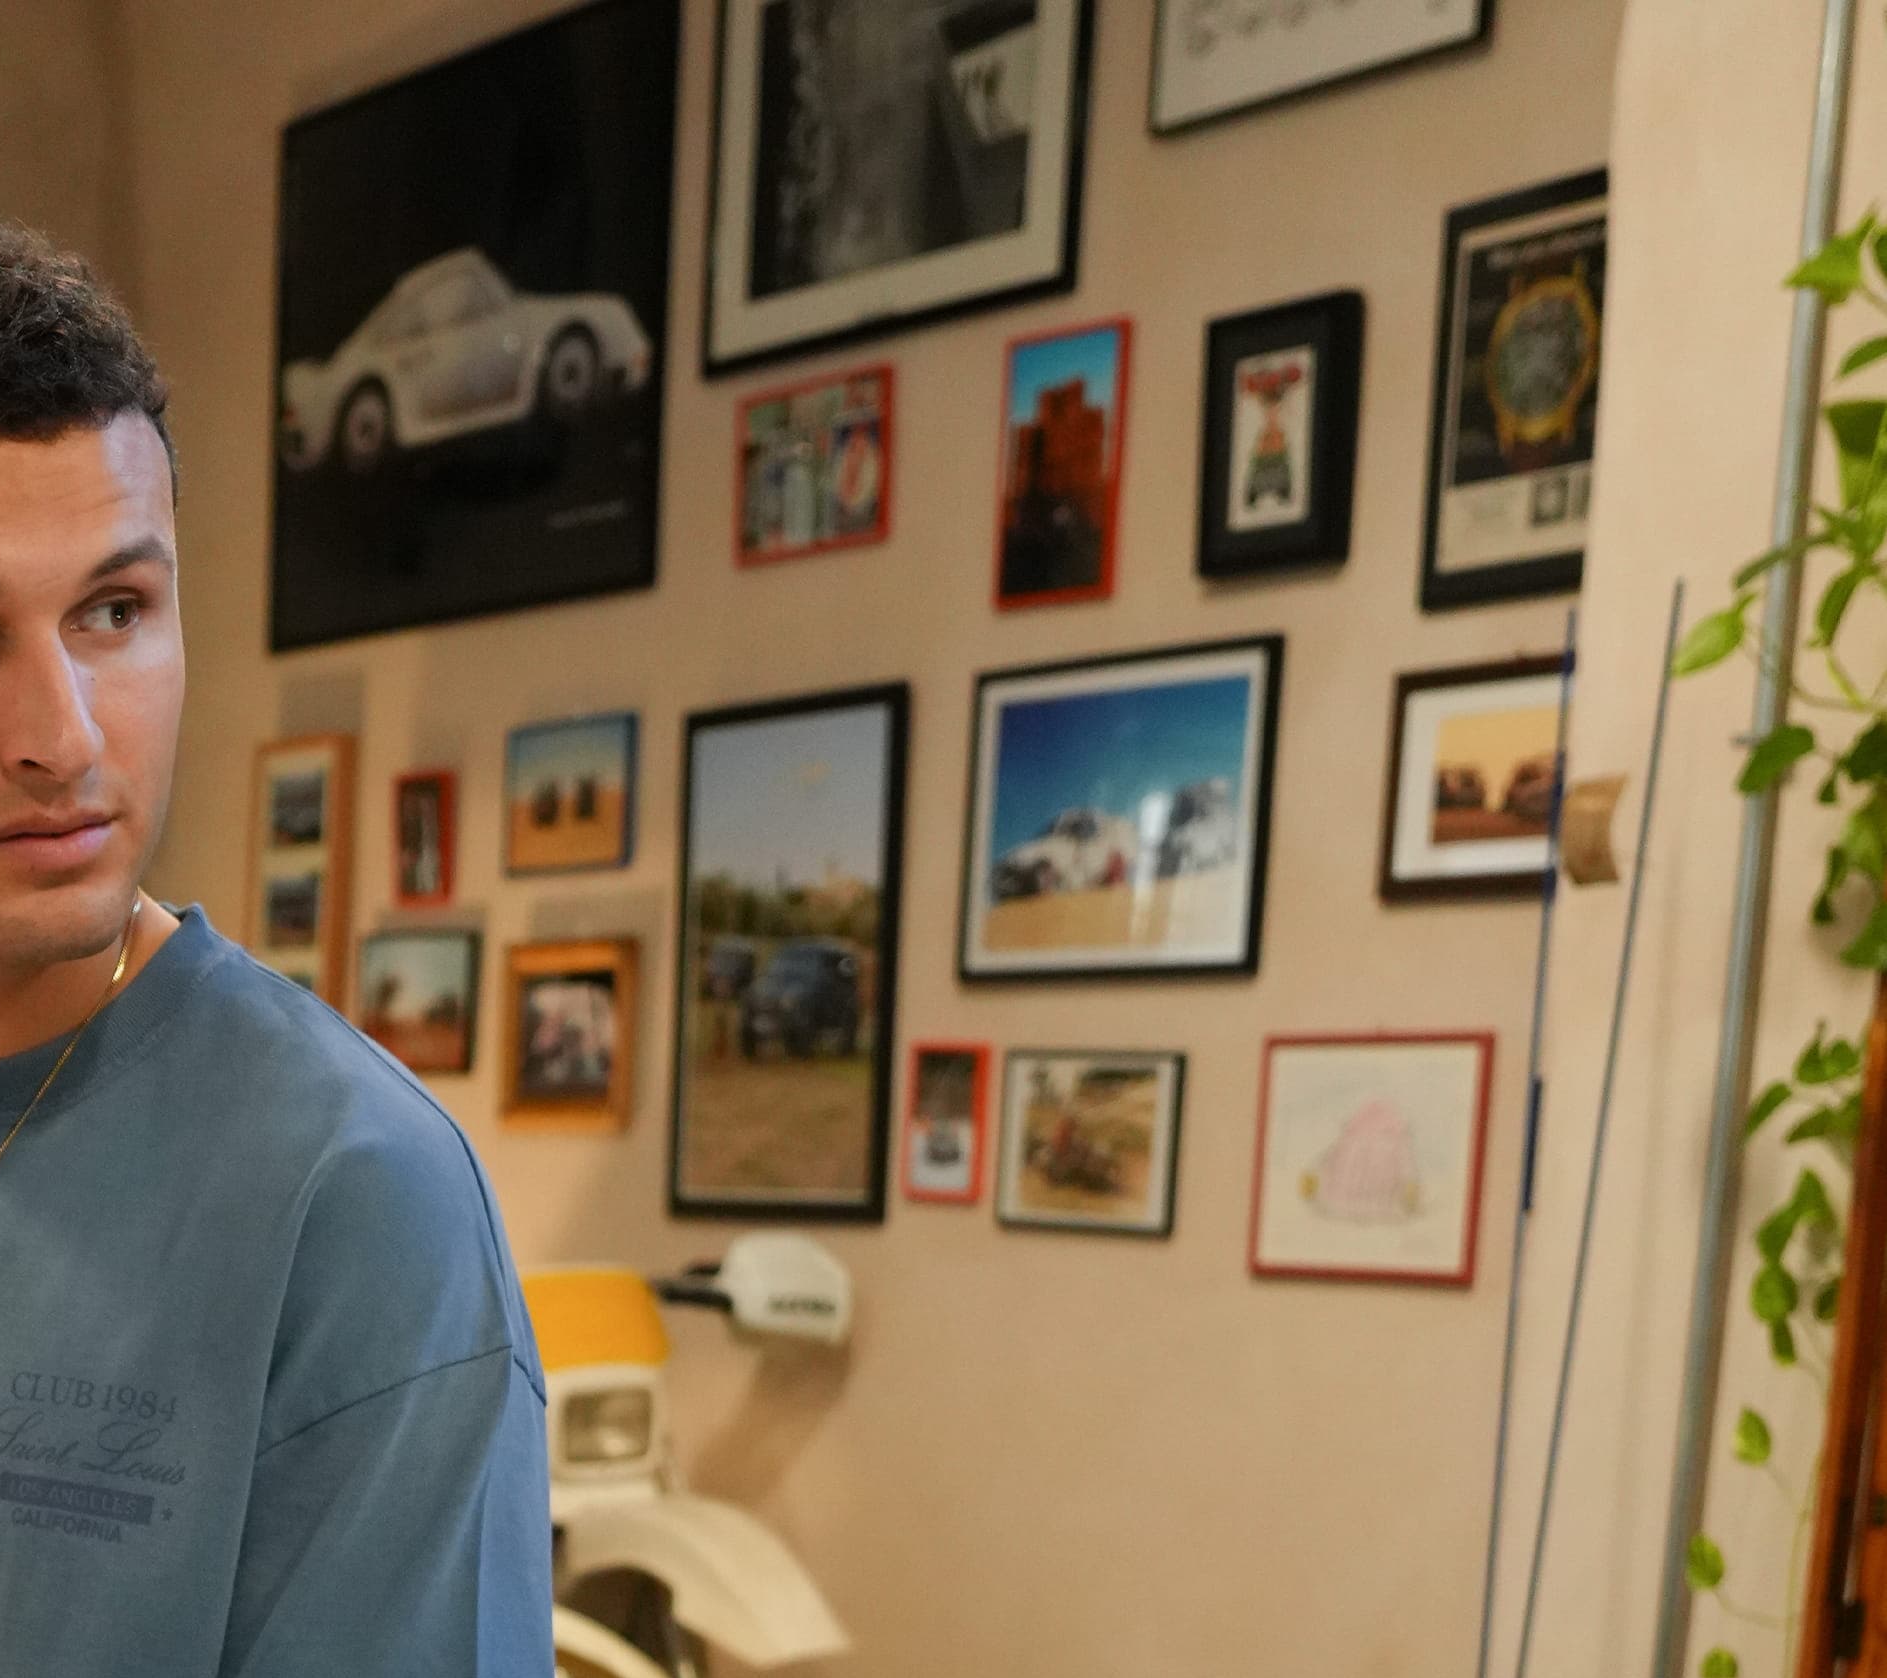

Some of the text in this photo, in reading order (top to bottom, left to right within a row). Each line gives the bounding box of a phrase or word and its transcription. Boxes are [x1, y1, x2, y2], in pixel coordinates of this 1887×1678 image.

[10, 1371, 179, 1424] CLUB 1984
[80, 1421, 187, 1485] Louis
[8, 1478, 139, 1518] LOS ANGELES
[11, 1507, 123, 1544] CALIFORNIA
